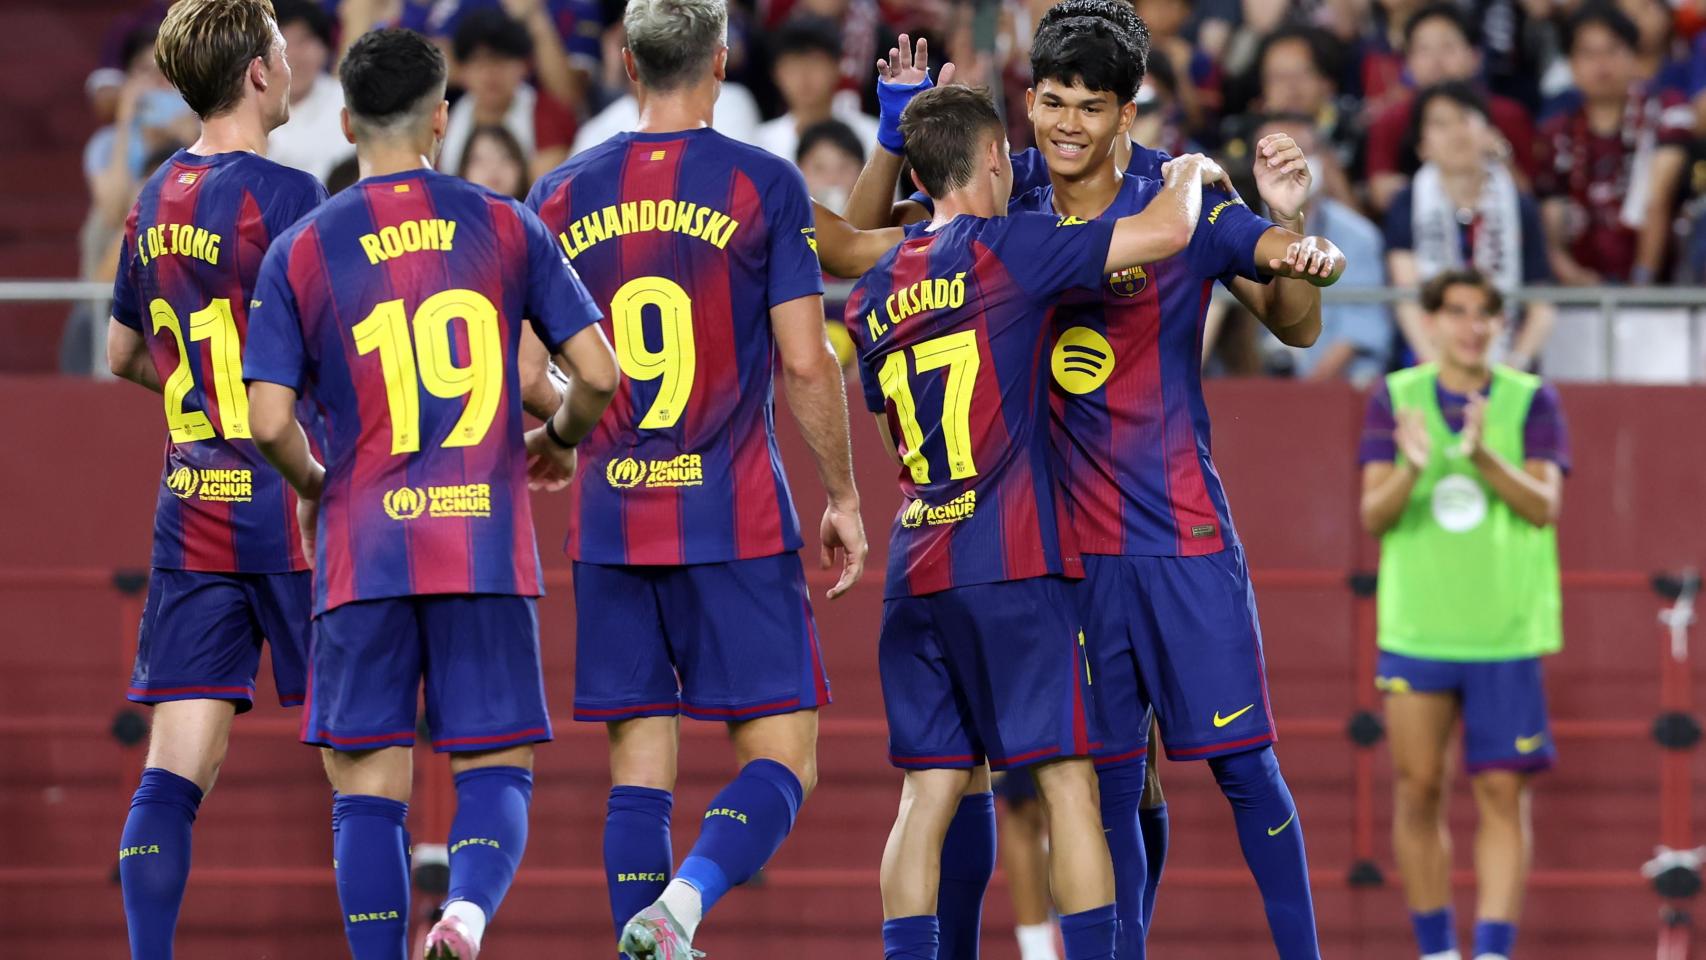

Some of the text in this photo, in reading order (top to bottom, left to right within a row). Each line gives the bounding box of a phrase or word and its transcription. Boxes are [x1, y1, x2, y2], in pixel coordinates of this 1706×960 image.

[147, 224, 168, 259] DE
[169, 224, 221, 265] JONG
[359, 219, 456, 265] ROONY
[559, 199, 739, 260] LEWANDOWSKI
[886, 271, 967, 324] CASADÓ
[149, 298, 252, 443] 21
[352, 288, 504, 455] 19
[610, 276, 696, 429] 9
[878, 329, 980, 484] 17
[199, 483, 252, 495] ACNUR
[201, 469, 252, 482] UNHCR
[428, 483, 490, 499] UNHCR
[646, 467, 703, 484] ACNUR
[429, 497, 491, 512] ACNUR
[927, 503, 976, 521] ACNUR
